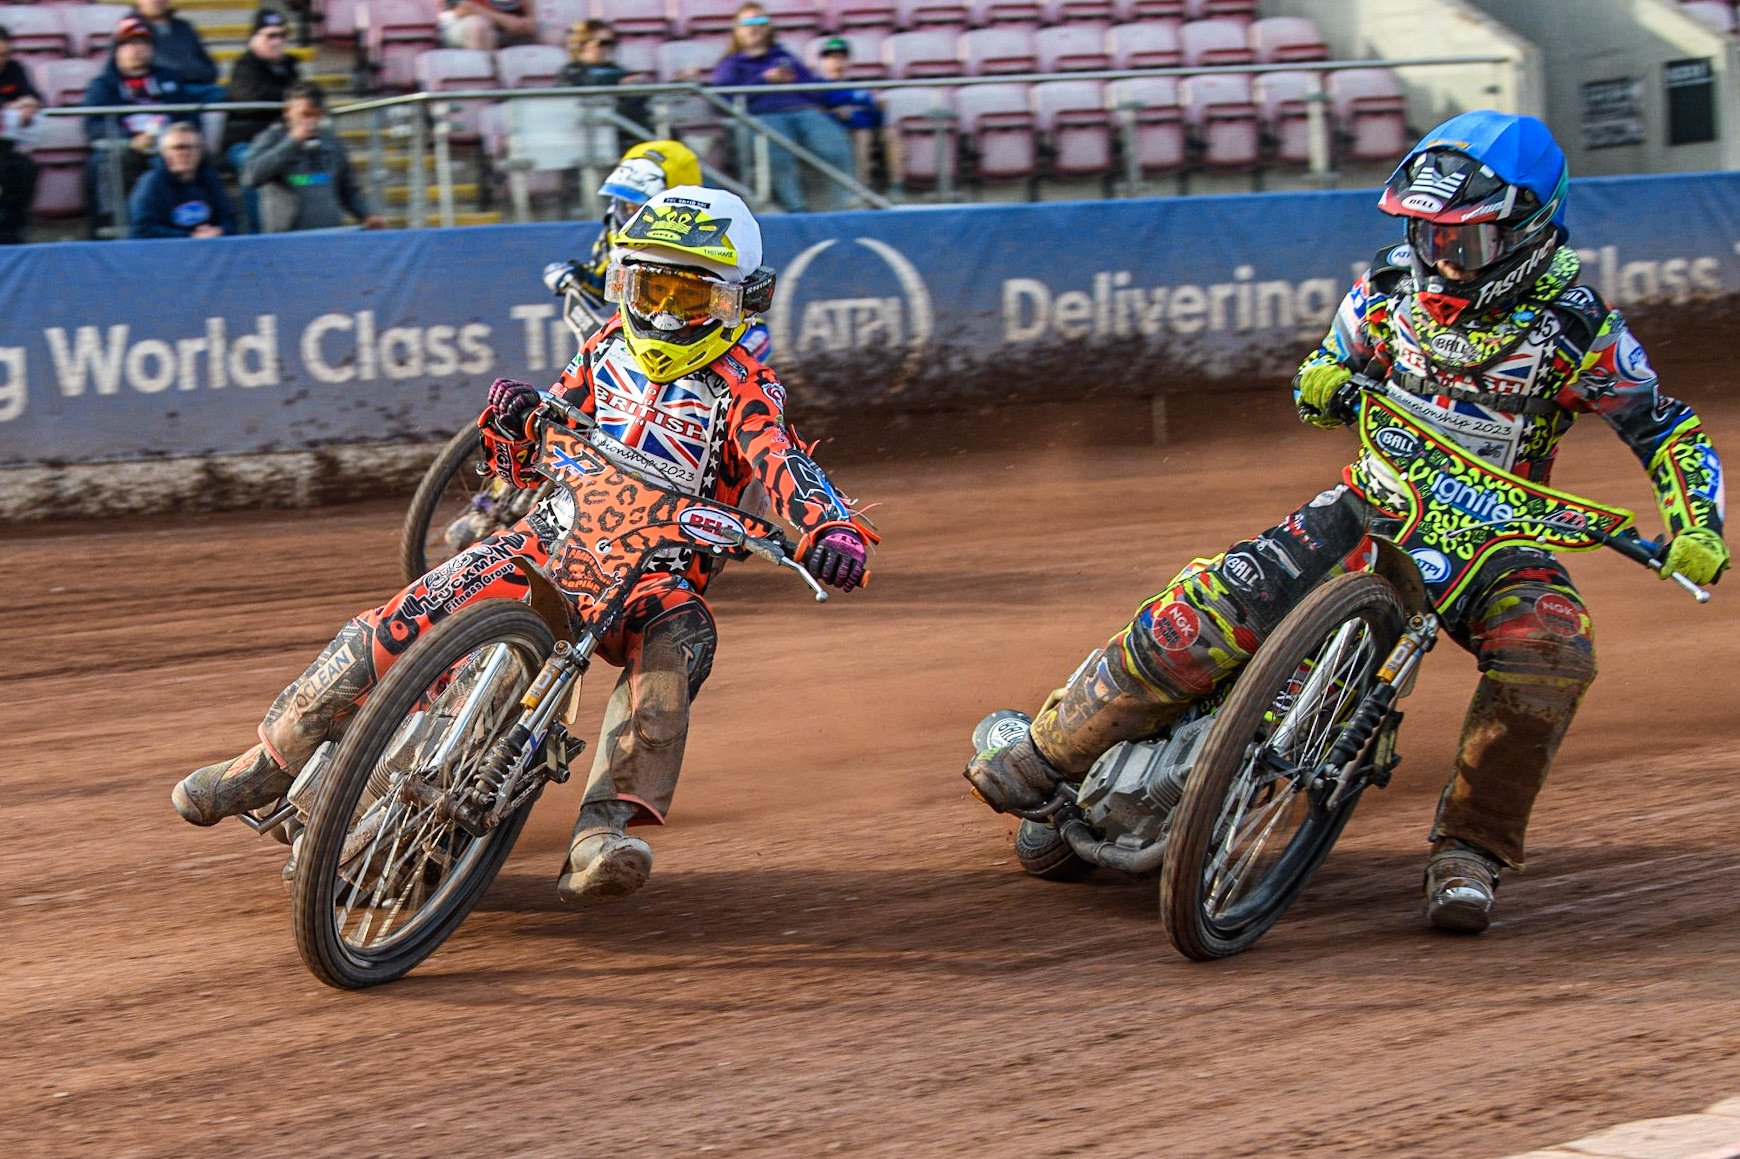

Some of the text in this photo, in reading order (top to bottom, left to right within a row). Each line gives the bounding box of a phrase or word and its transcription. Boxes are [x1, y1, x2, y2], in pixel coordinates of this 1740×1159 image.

[1002, 264, 1339, 343] Delivering
[44, 313, 281, 397] World
[301, 309, 496, 384] Class
[594, 385, 707, 443] BRITISH
[1473, 421, 1513, 437] 2023
[659, 461, 696, 483] 2023
[444, 562, 516, 613] Fitness Group
[1226, 556, 1259, 587] BALL
[1168, 605, 1195, 637] NGK
